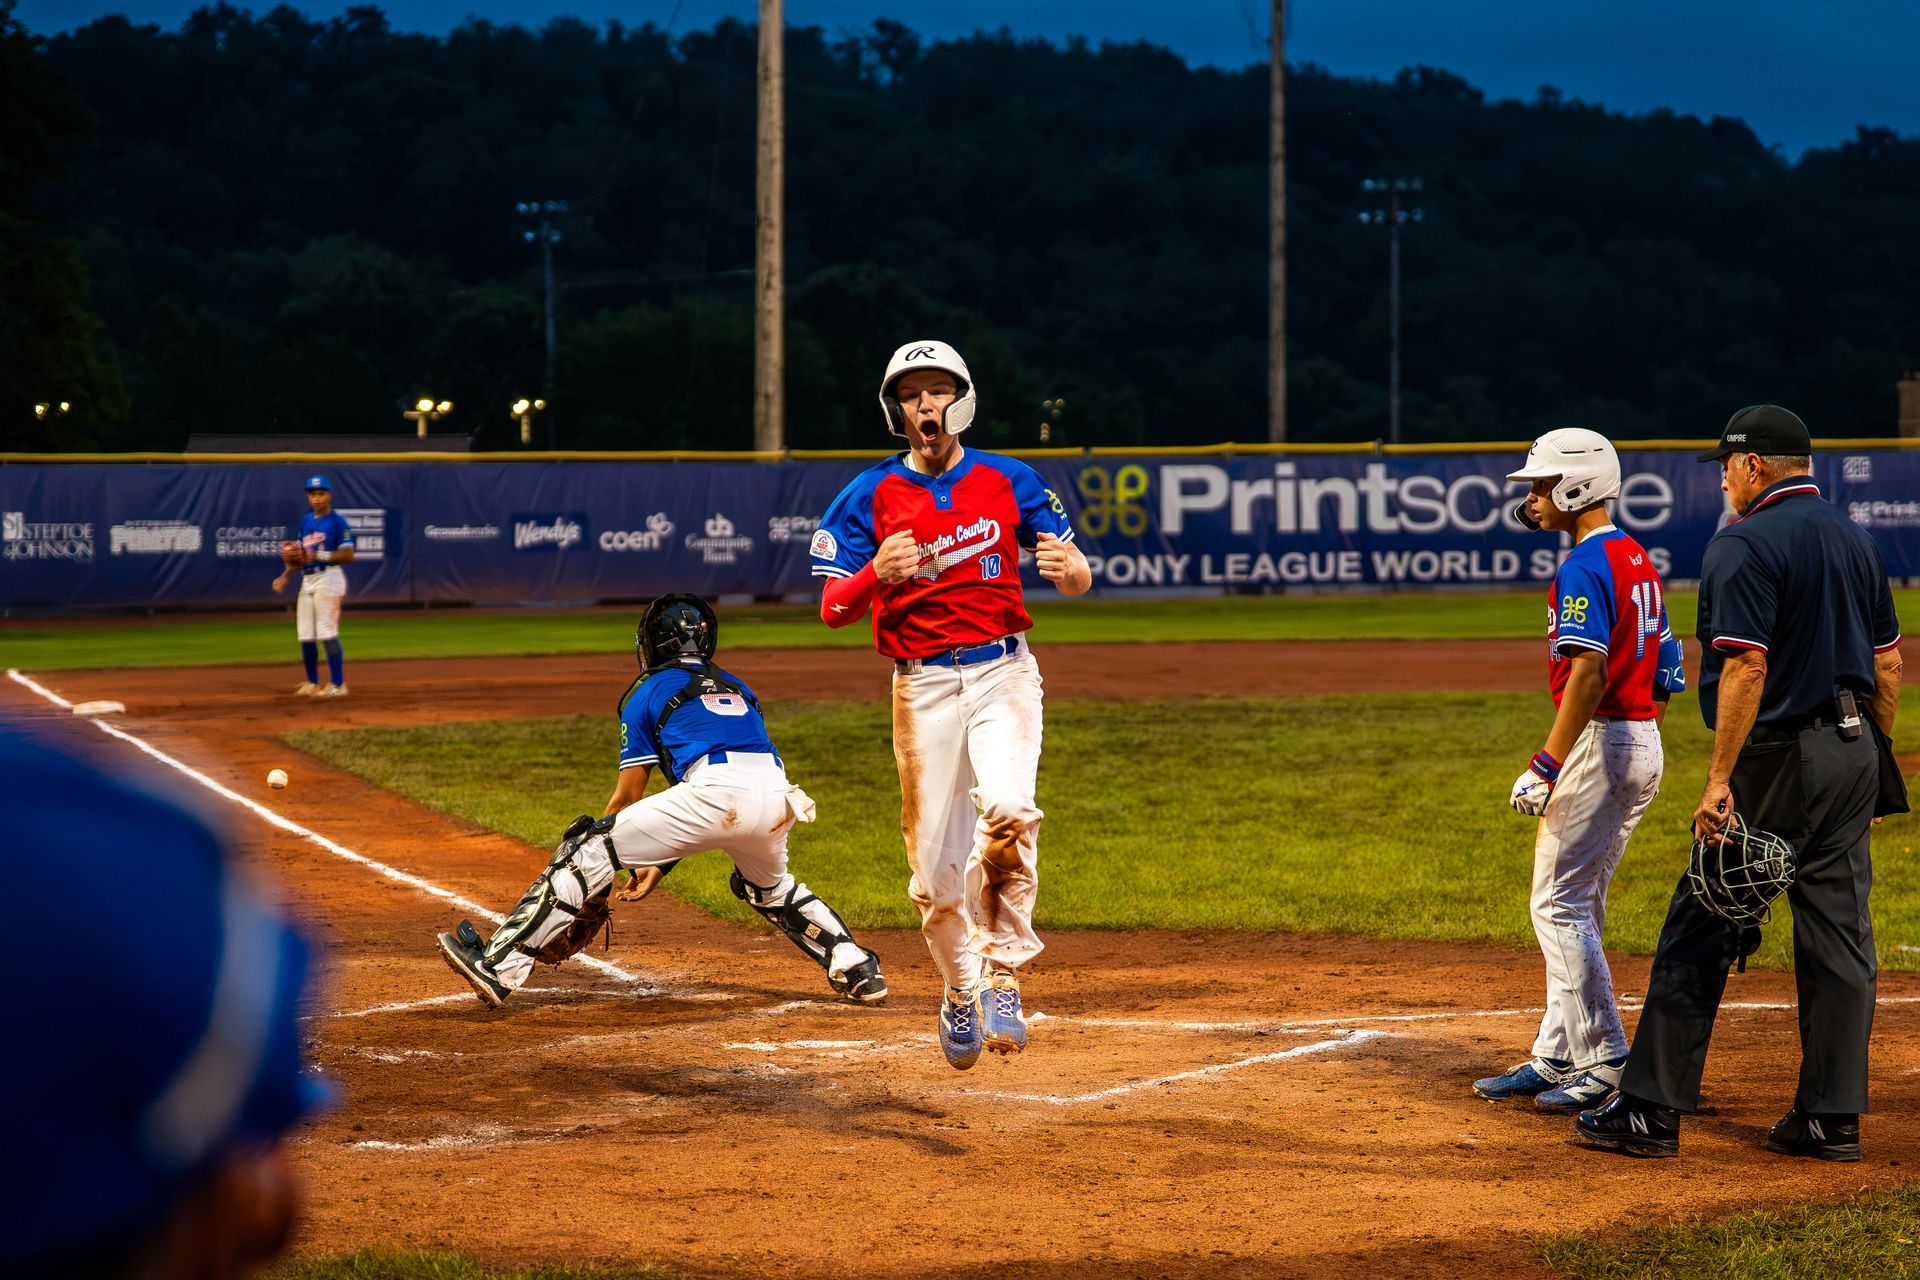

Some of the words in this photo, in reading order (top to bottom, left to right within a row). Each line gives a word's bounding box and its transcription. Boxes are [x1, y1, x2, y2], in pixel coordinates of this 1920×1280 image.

[1726, 434, 1747, 442] UMPIRE
[1160, 462, 1673, 548] Printscae
[24, 522, 94, 539] STEPTOE
[215, 526, 287, 541] COMCAST
[514, 516, 581, 549] Wendy's
[599, 530, 661, 551] coen
[918, 534, 955, 560] hington
[956, 516, 990, 542] County
[979, 553, 1002, 580] 10
[1201, 551, 1362, 584] LEAGUE
[1372, 550, 1521, 581] WORLD
[1630, 580, 1662, 660] 14
[1629, 1111, 1650, 1135] N
[1808, 1118, 1826, 1140] N
